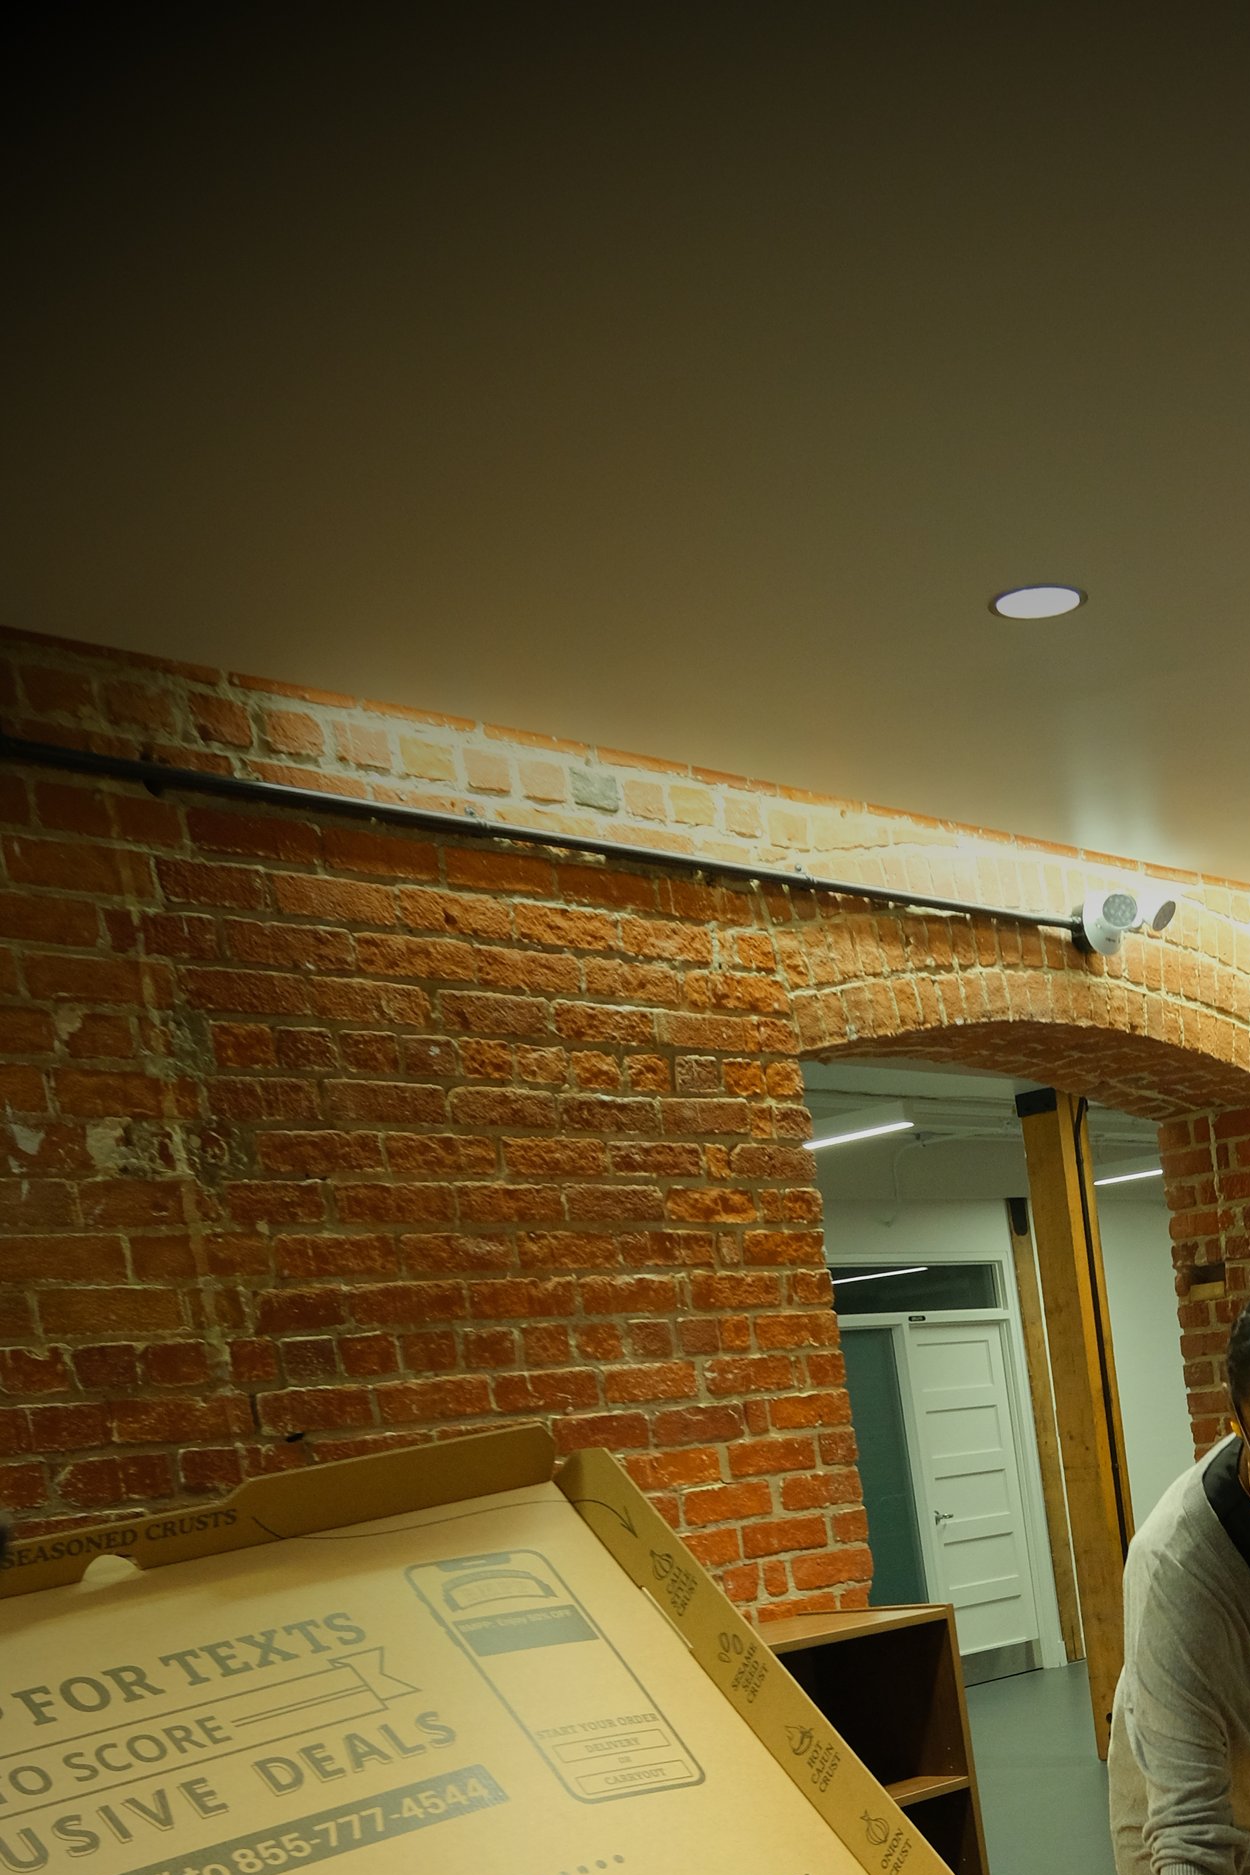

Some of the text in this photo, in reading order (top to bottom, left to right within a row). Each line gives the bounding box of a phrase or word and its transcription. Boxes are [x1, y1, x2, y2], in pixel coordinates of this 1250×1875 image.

[0, 1508, 238, 1571] SEASONED CRUSTS
[10, 1612, 366, 1726] FOR TEXTS
[747, 1662, 769, 1703] CRUST
[535, 1712, 660, 1740] START YOUR ORDER
[585, 1737, 641, 1754] DELIVERY
[62, 1715, 233, 1782] SCORE
[805, 1740, 825, 1770] HOT
[810, 1742, 836, 1785] CAJUN
[0, 1711, 456, 1874] USIVE DEALS
[604, 1767, 667, 1787] CARRYOUT
[818, 1751, 842, 1793] CRUST
[231, 1778, 488, 1875] 855-777-4544
[880, 1827, 904, 1870] ONION
